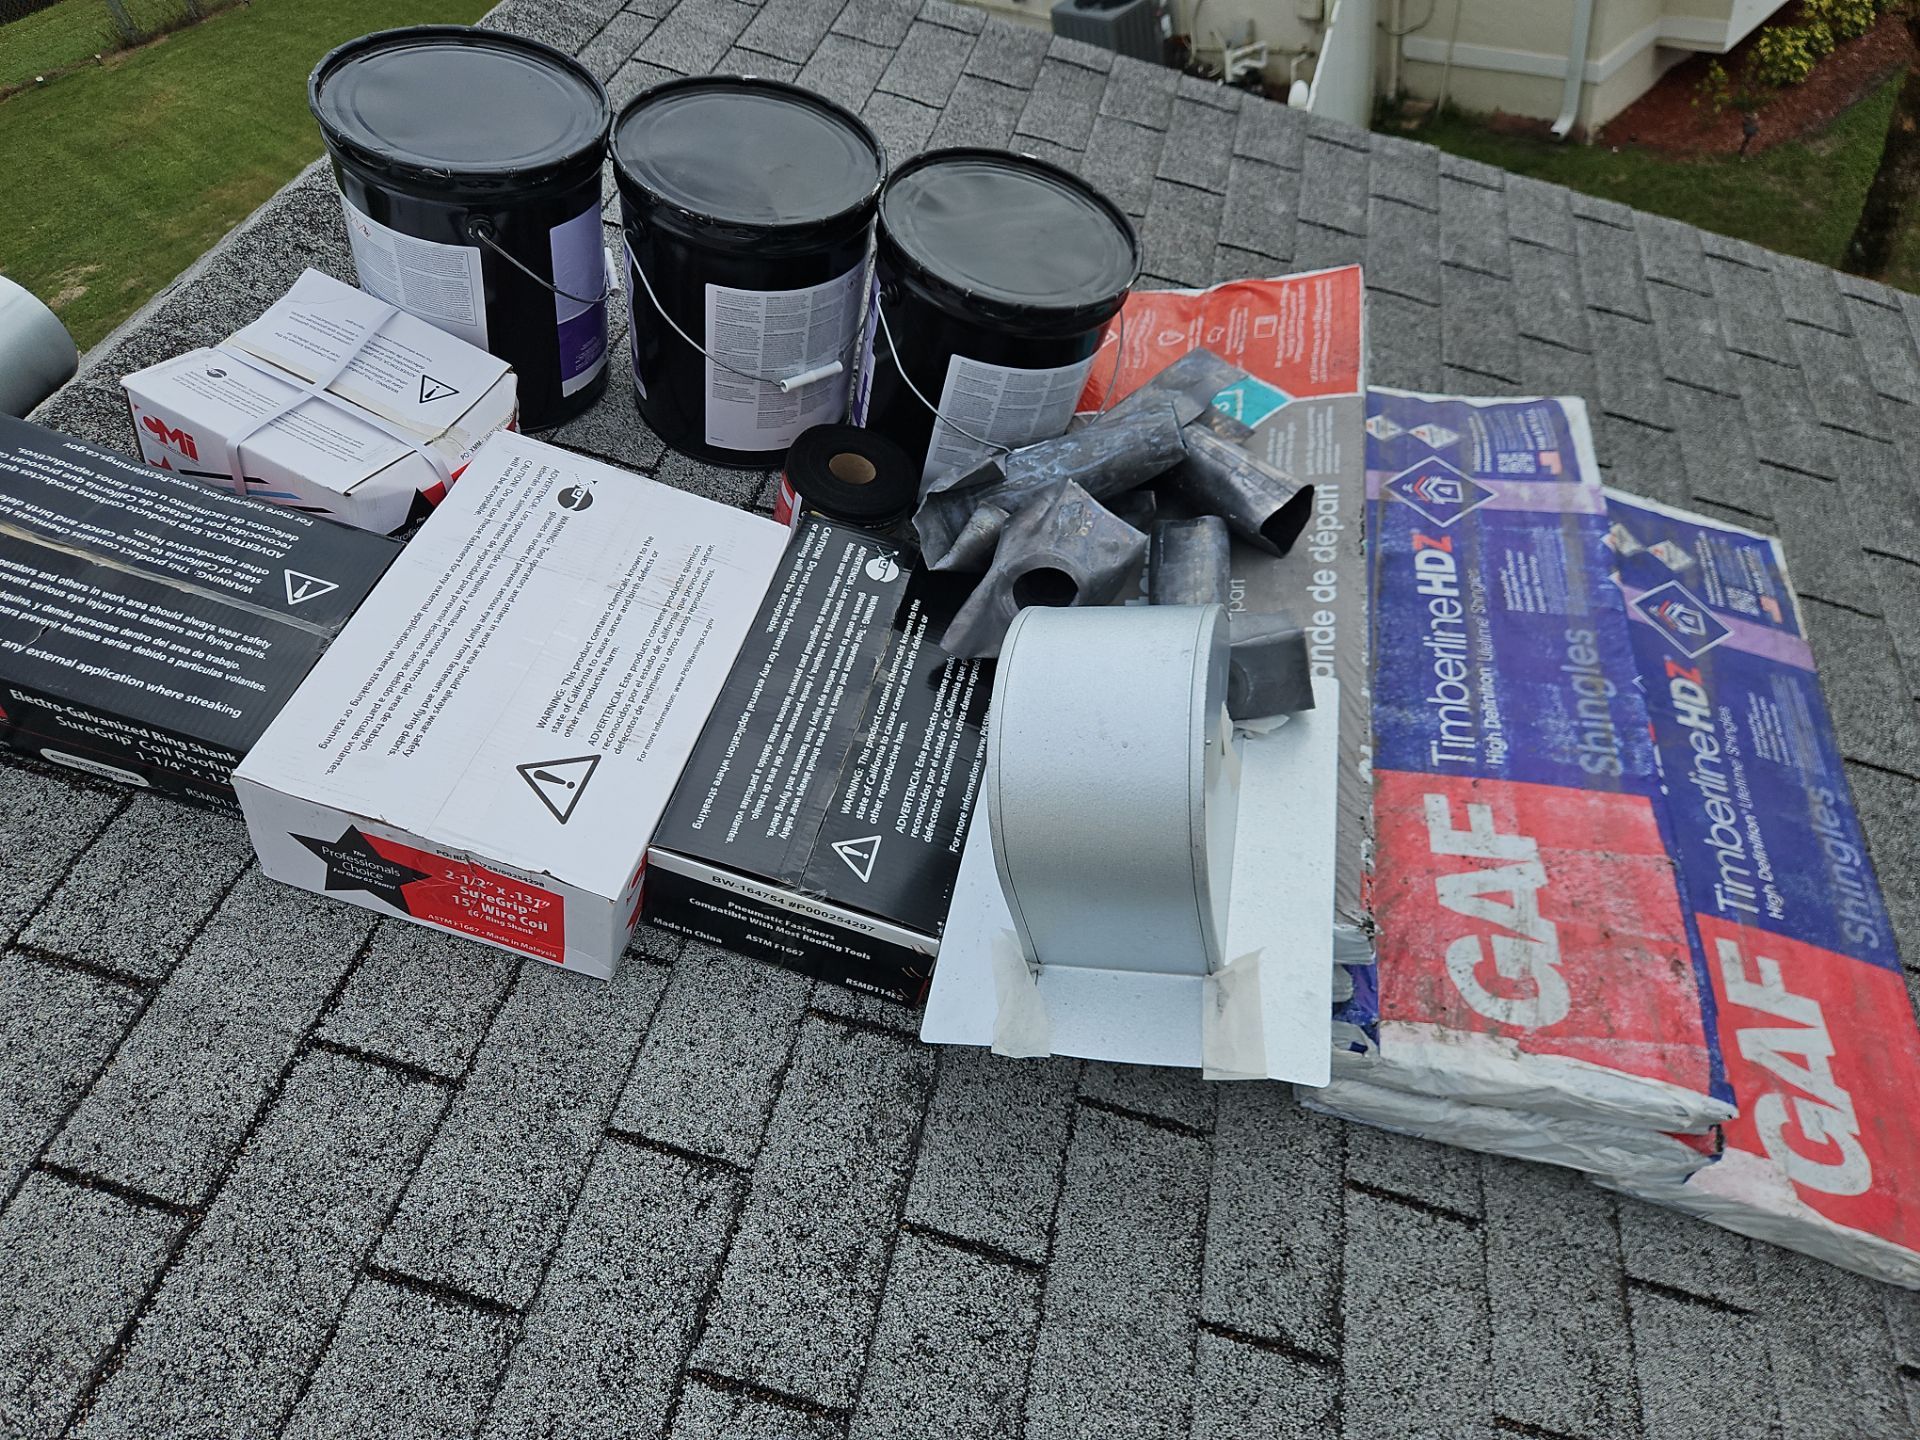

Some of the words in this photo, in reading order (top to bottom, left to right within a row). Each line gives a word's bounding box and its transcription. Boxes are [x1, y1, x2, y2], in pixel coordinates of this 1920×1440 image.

[199, 488, 264, 511] information:
[265, 507, 294, 519] more
[544, 515, 569, 545] WARNING:
[1307, 483, 1344, 562] départ
[651, 550, 658, 558] or
[806, 560, 817, 571] Do
[515, 559, 539, 588] operators
[636, 558, 654, 582] defects
[800, 566, 811, 584] not
[1306, 568, 1337, 601] de
[507, 589, 519, 602] and
[625, 582, 641, 599] birth
[795, 583, 806, 596] use
[1228, 578, 1246, 611] part
[1467, 568, 1486, 613] Shingles
[493, 602, 510, 623] others
[619, 598, 631, 613] and
[786, 597, 801, 617] these
[487, 623, 498, 631] in
[535, 688, 566, 728] WARNING:
[560, 670, 576, 685] This
[572, 640, 594, 671] product
[590, 610, 611, 640] contains
[607, 577, 630, 610] chemicals
[624, 554, 643, 577] known
[642, 535, 654, 546] the
[606, 613, 622, 636] cancer
[772, 617, 793, 650] fasteners
[476, 631, 491, 649] work
[594, 637, 610, 658] cause
[1304, 609, 1336, 677] ande
[465, 648, 480, 664] area
[587, 688, 624, 746] ADVERTENCIA:
[618, 672, 633, 688] Este
[629, 638, 651, 672] producto
[648, 607, 668, 637] contiene
[663, 573, 686, 608] productos
[587, 658, 598, 666] to
[601, 702, 631, 750] reconocidos
[627, 688, 638, 703] por
[635, 679, 643, 687] el
[639, 654, 656, 680] estado
[652, 644, 662, 654] de
[657, 611, 680, 644] California
[676, 597, 687, 610] que
[683, 566, 703, 597] provocan
[758, 663, 771, 678] any
[767, 651, 779, 663] for
[1, 640, 26, 653] any
[25, 647, 77, 667] external
[75, 663, 144, 688] application
[146, 683, 184, 699] where
[184, 695, 242, 718] streaking
[449, 664, 469, 689] should
[566, 667, 593, 703] California
[432, 689, 453, 714] always
[563, 715, 579, 737] other
[576, 666, 607, 715] reproductive
[601, 646, 620, 666] harm.
[613, 715, 638, 754] defecotos
[633, 704, 644, 715] de
[640, 662, 666, 704] nacimiento
[665, 637, 679, 656] otros
[745, 678, 765, 711] external
[1477, 667, 1502, 729] Definition
[1557, 626, 1622, 777] Shingles
[563, 702, 572, 713] of
[644, 732, 657, 750] more
[651, 692, 676, 732] information:
[9, 688, 149, 737] Electro-Galvanized
[150, 730, 187, 750] Ring
[188, 742, 239, 769] Shank
[419, 715, 436, 733] wear
[551, 713, 566, 733] state
[725, 711, 750, 757] application
[1718, 705, 1740, 756] Shingles
[138, 740, 171, 756] Coil
[175, 750, 231, 778] Roofin
[402, 733, 423, 757] safety
[1484, 731, 1507, 764] High
[712, 759, 730, 786] where
[691, 786, 717, 829] streaking
[1741, 811, 1773, 882] Definition
[341, 861, 383, 880] Choice
[1799, 780, 1885, 950] Shingles
[712, 875, 785, 906] BW-164754
[1761, 883, 1784, 919] High
[480, 902, 516, 921] Wire
[519, 916, 547, 931] Coil
[727, 901, 782, 924] Pneumatic
[785, 920, 834, 940] Fasteners
[1424, 792, 1570, 1027] GAF
[427, 914, 452, 924] ASTM
[486, 931, 509, 942] Made
[520, 942, 556, 957] Malaysia
[485, 915, 505, 926] Ring
[506, 922, 533, 935] Shank
[653, 917, 680, 930] Made
[682, 926, 692, 934] In
[694, 930, 721, 943] China
[689, 897, 747, 920] Compatible
[749, 916, 773, 929] With
[775, 925, 800, 938] Most
[802, 934, 842, 951] Roofing
[844, 946, 870, 959] Tools
[745, 933, 772, 947] ASTM
[1715, 938, 1873, 1196] GAF
